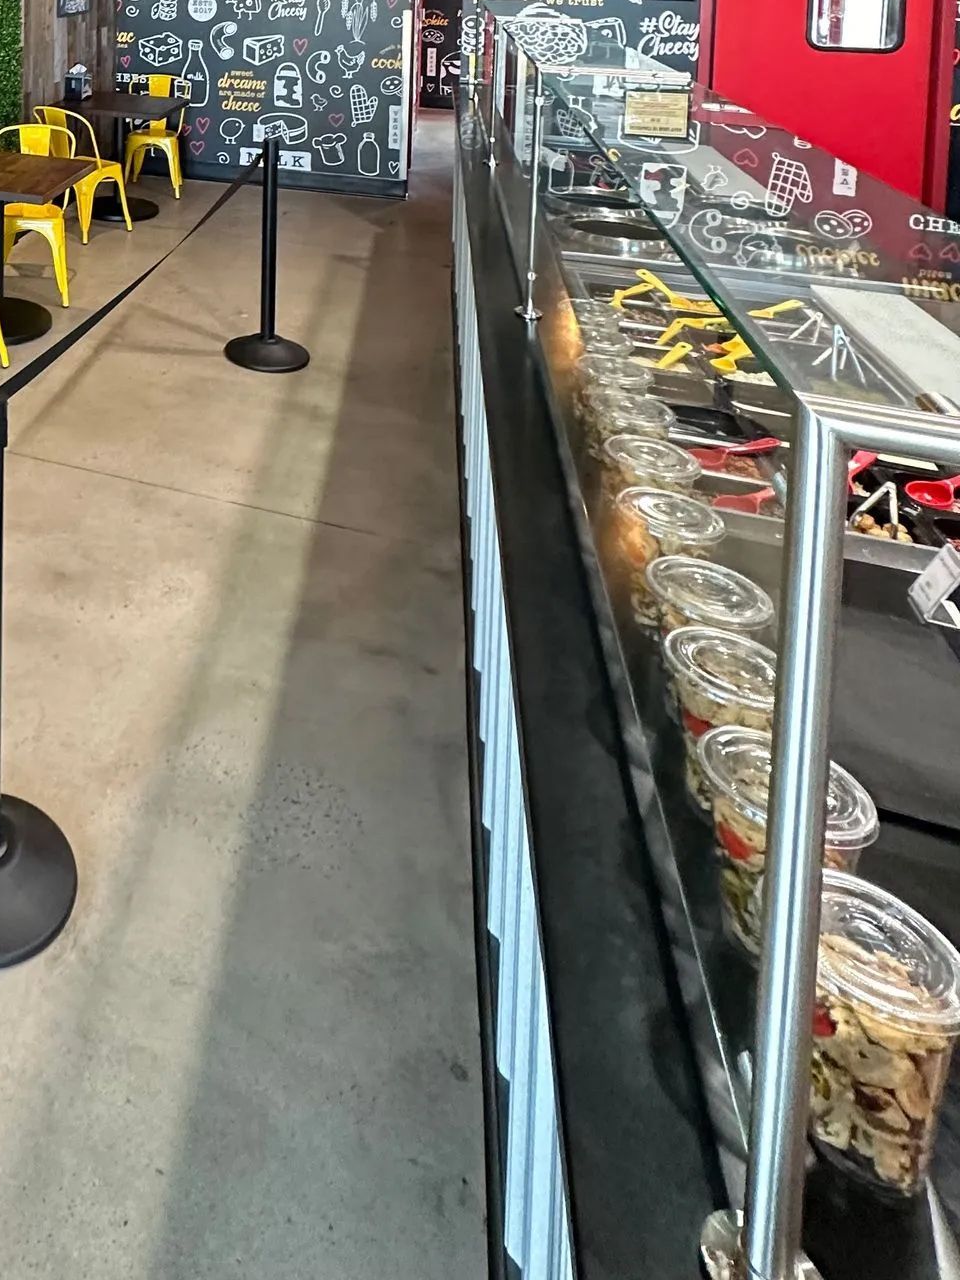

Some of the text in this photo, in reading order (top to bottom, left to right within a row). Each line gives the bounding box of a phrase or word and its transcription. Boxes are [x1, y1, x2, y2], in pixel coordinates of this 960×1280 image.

[267, 1, 307, 22] Cheesy
[639, 10, 700, 41] #Stay
[637, 34, 700, 61] Cheesy
[218, 72, 268, 90] dreams
[221, 95, 262, 112] cheese
[246, 151, 305, 169] MLK
